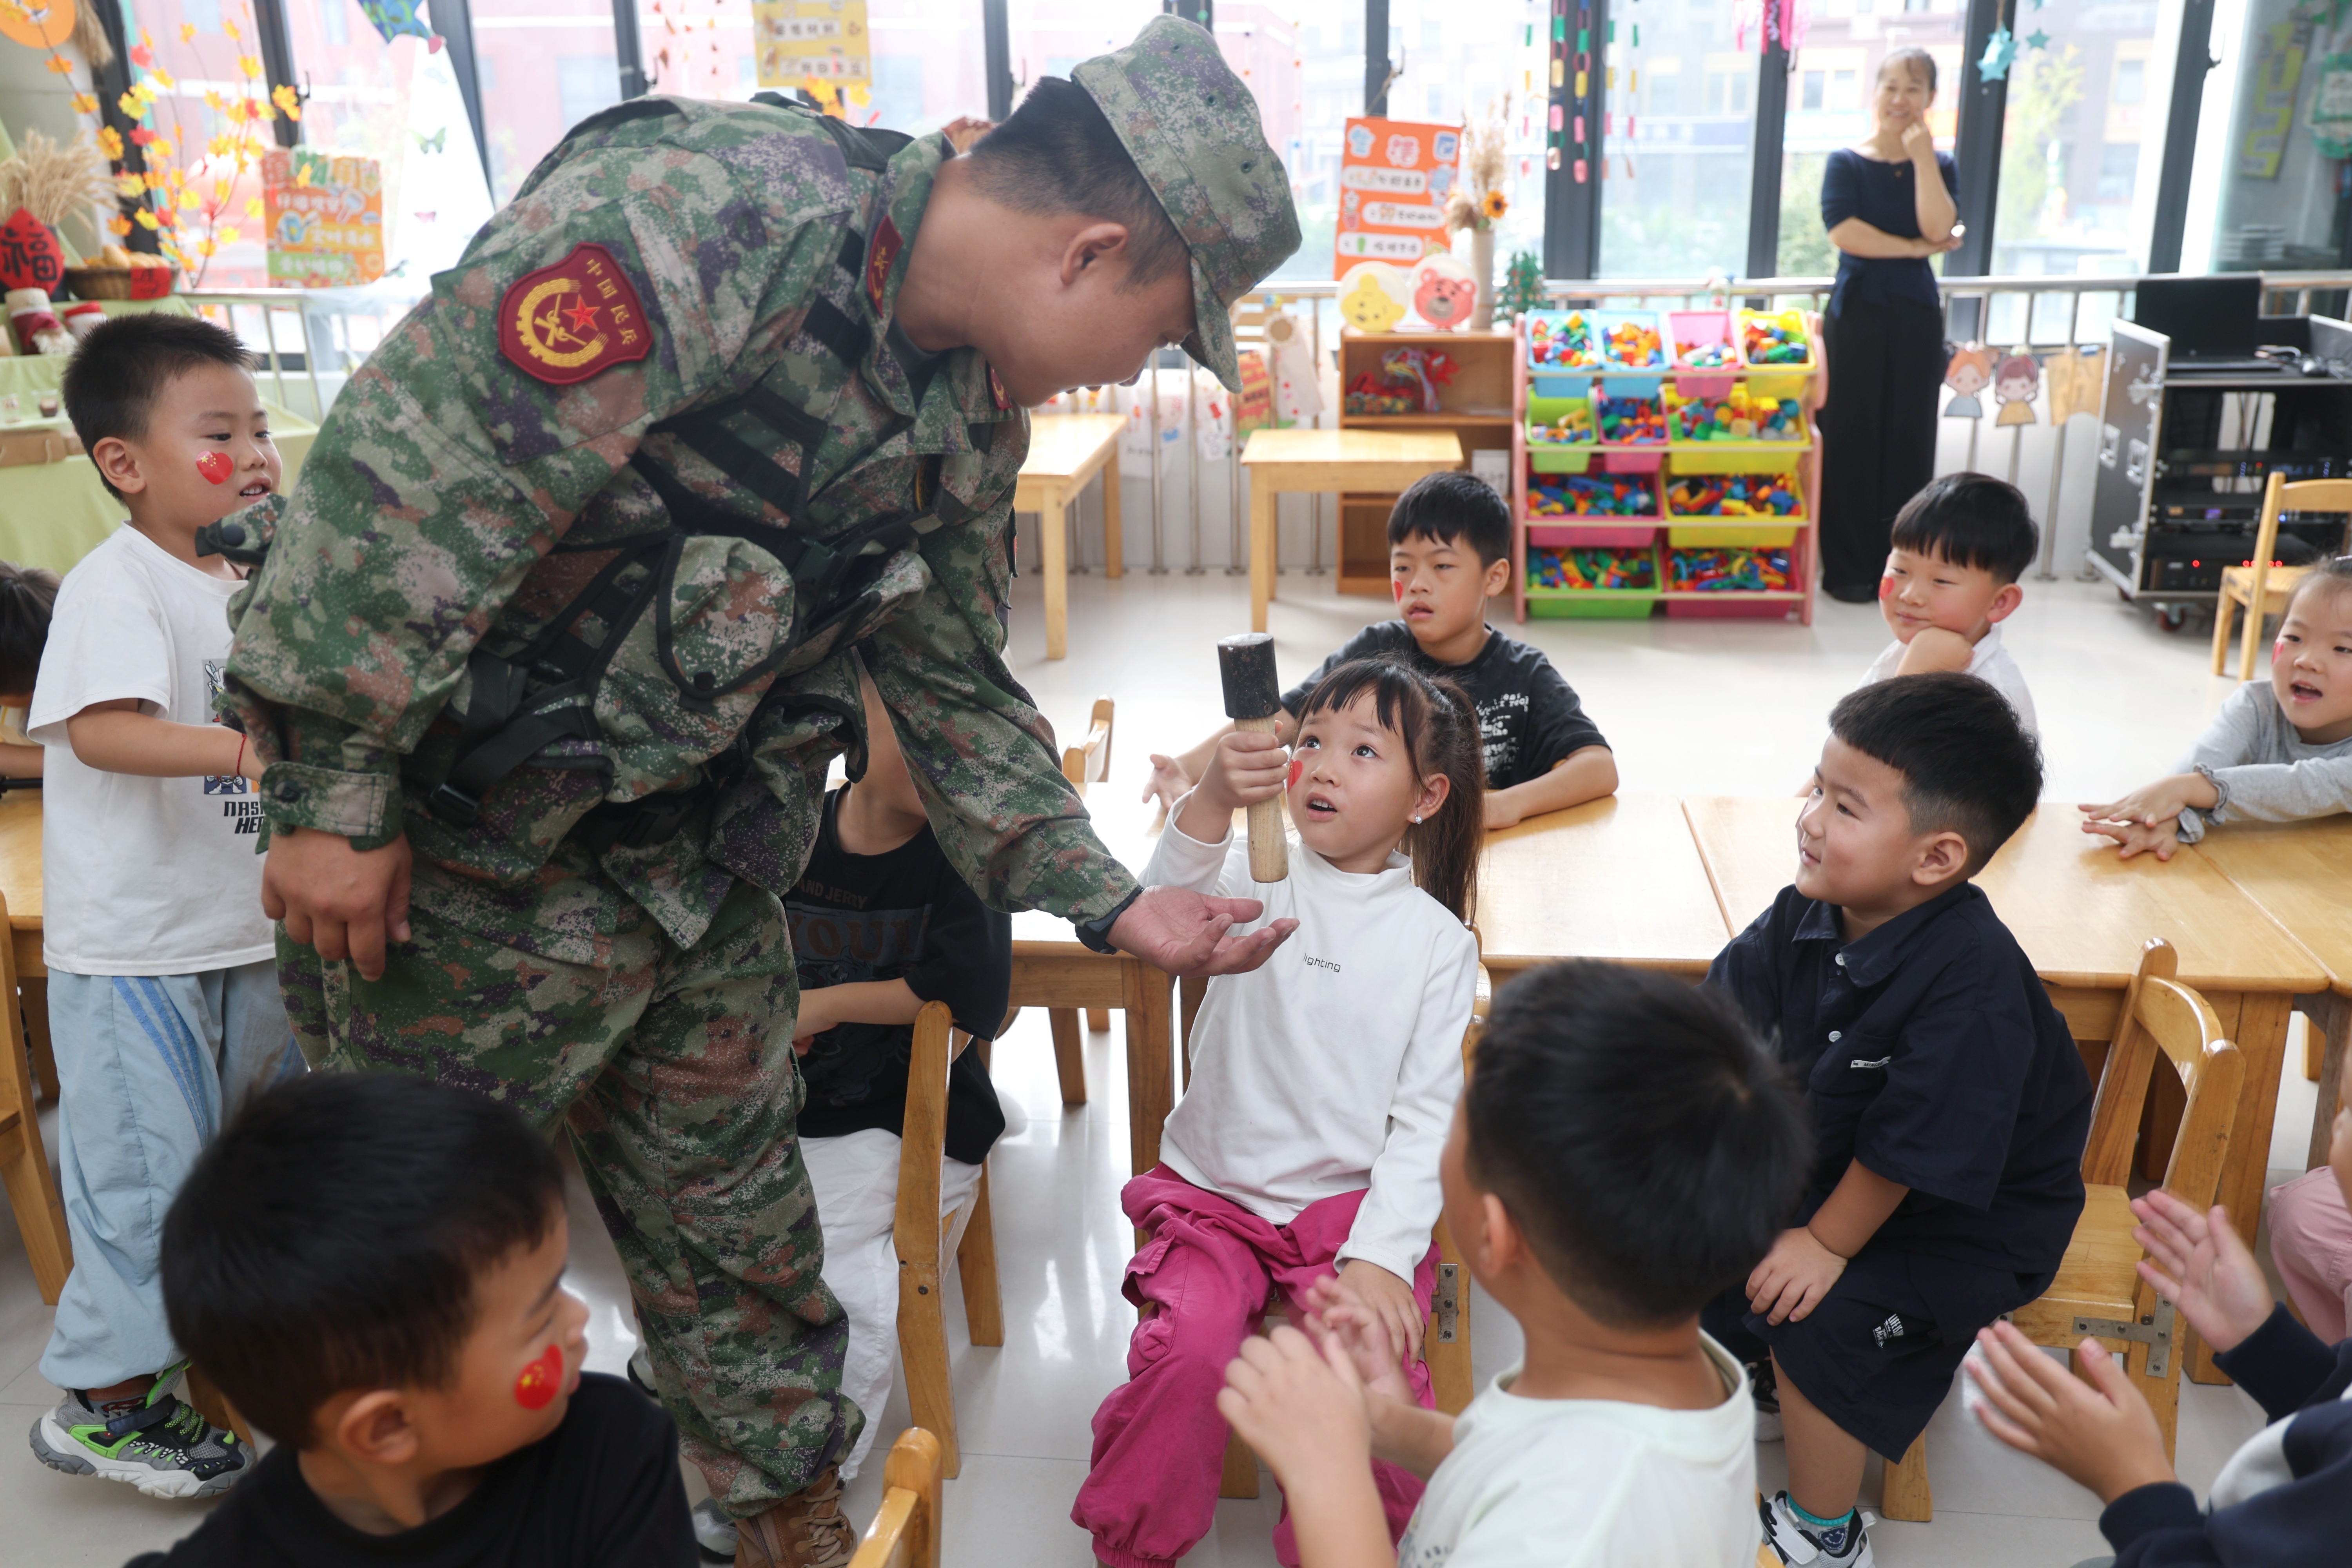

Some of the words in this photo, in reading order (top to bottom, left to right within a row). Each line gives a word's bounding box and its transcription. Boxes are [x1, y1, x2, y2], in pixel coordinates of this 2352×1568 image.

[1, 220, 57, 281] 福
[587, 259, 638, 345] 中国民兵
[825, 886, 868, 909] JERRY
[1303, 953, 1341, 973] lighting
